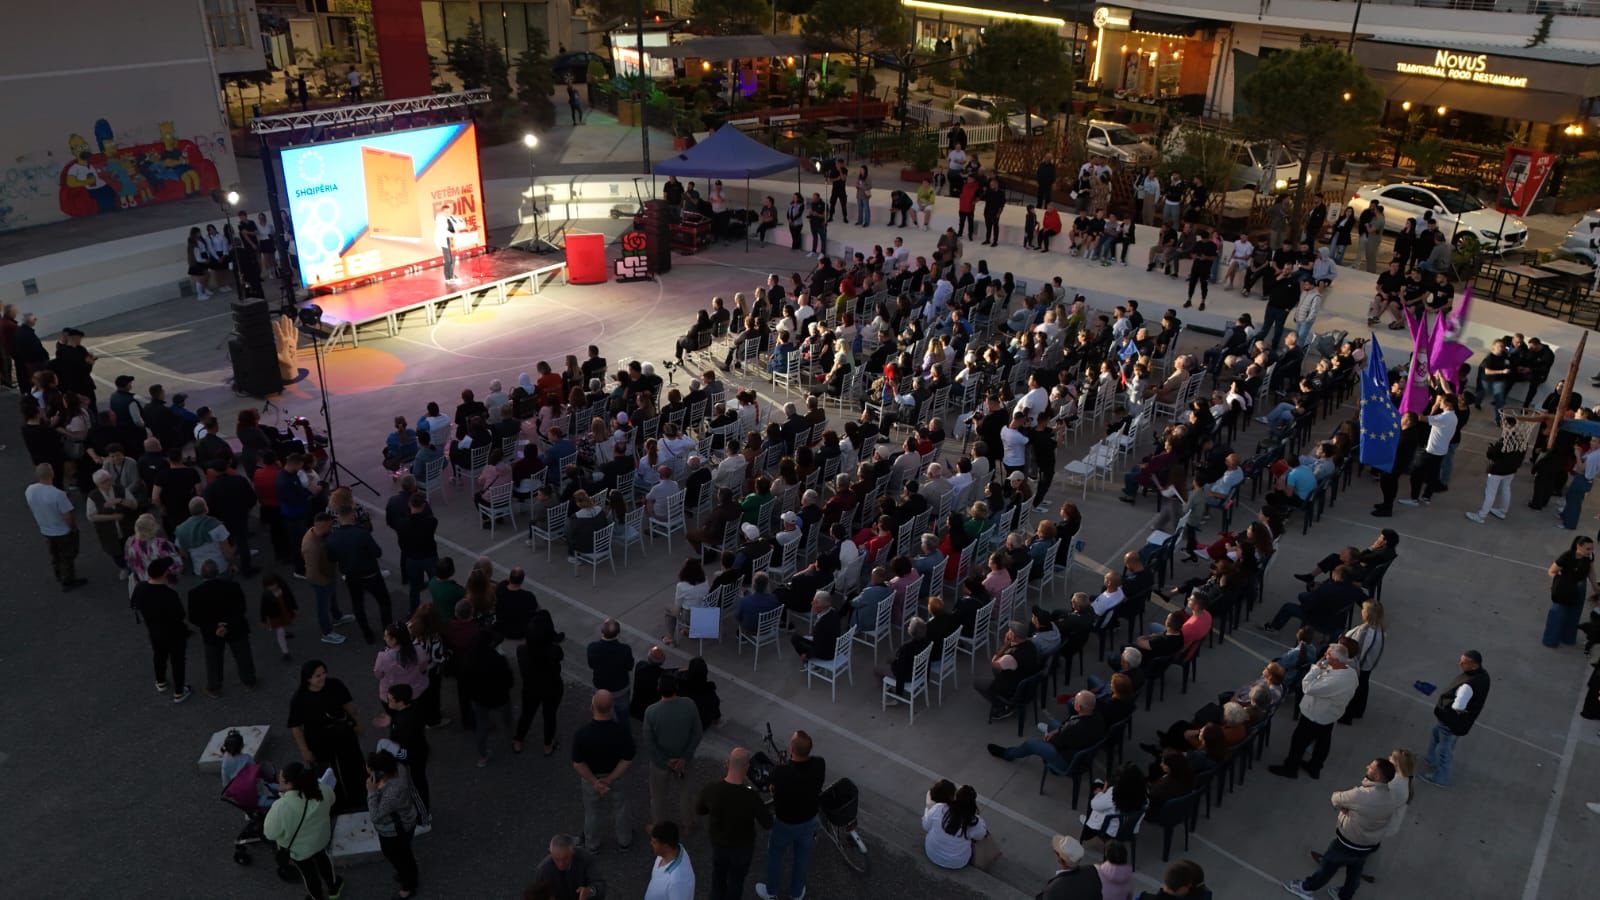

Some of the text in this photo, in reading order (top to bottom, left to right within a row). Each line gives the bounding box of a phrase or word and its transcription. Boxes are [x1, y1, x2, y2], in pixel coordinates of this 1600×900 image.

[1397, 62, 1528, 88] TRADITIONAL FOOD RESTAURANT
[296, 183, 338, 198] SHQIPËRIA
